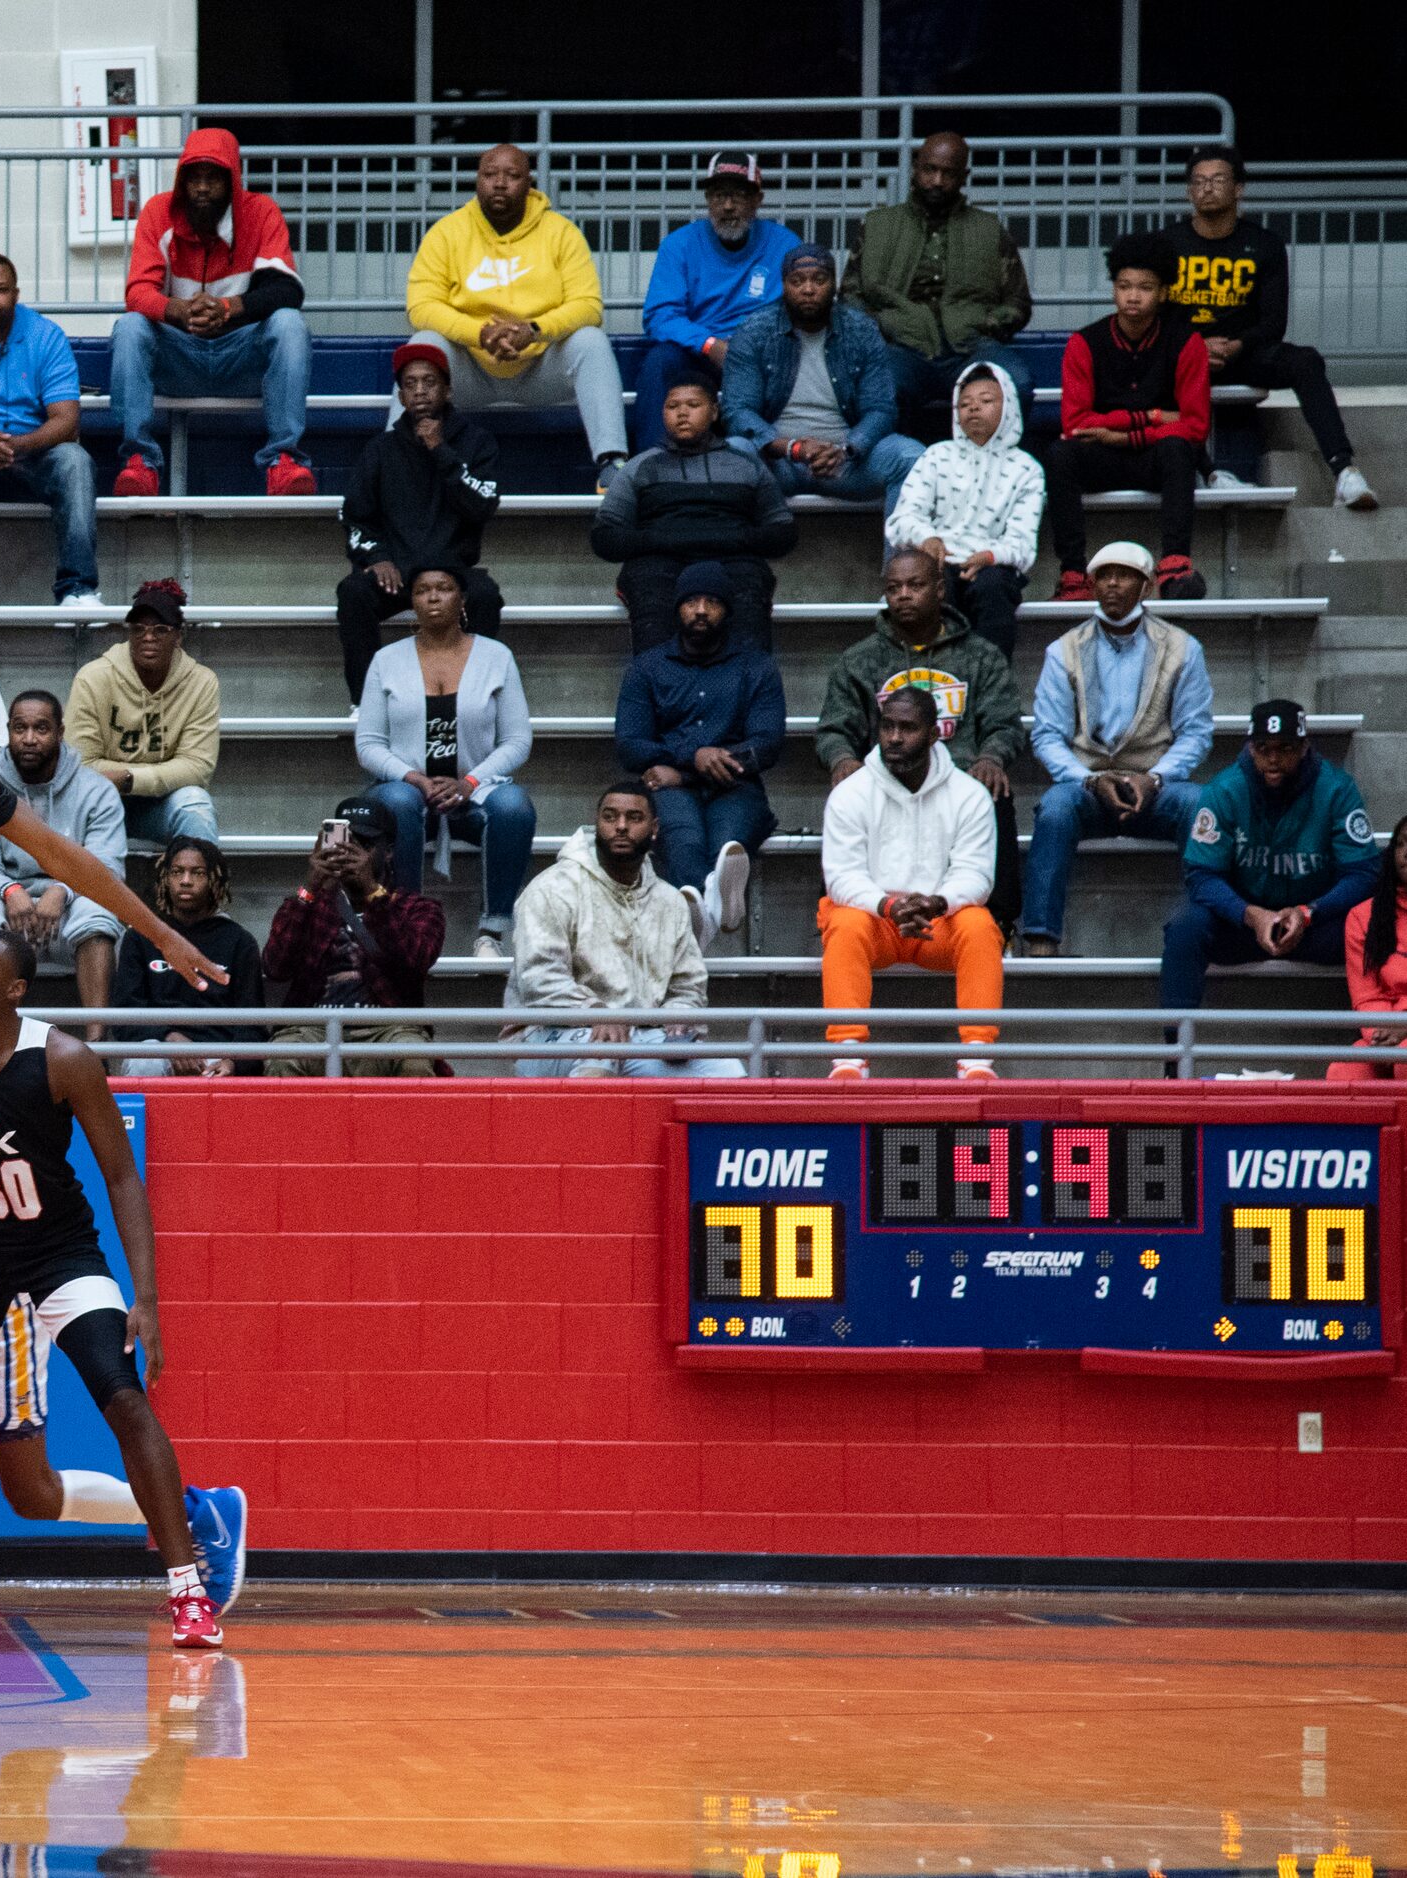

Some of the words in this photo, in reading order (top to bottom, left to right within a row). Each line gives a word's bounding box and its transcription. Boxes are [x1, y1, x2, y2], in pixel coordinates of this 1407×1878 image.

[715, 1149, 828, 1188] HOME
[1227, 1149, 1371, 1189] VISITOR
[705, 1206, 834, 1299] 70
[982, 1251, 1084, 1268] SPECTRUM
[1233, 1208, 1366, 1300] 70
[1024, 1267, 1048, 1277] HOME
[1050, 1267, 1072, 1277] TEAM
[910, 1275, 922, 1299] 1
[951, 1275, 968, 1299] 2
[1094, 1275, 1111, 1300] 3
[1141, 1276, 1158, 1300] 4
[750, 1317, 787, 1338] BON.
[1283, 1319, 1320, 1341] BON.
